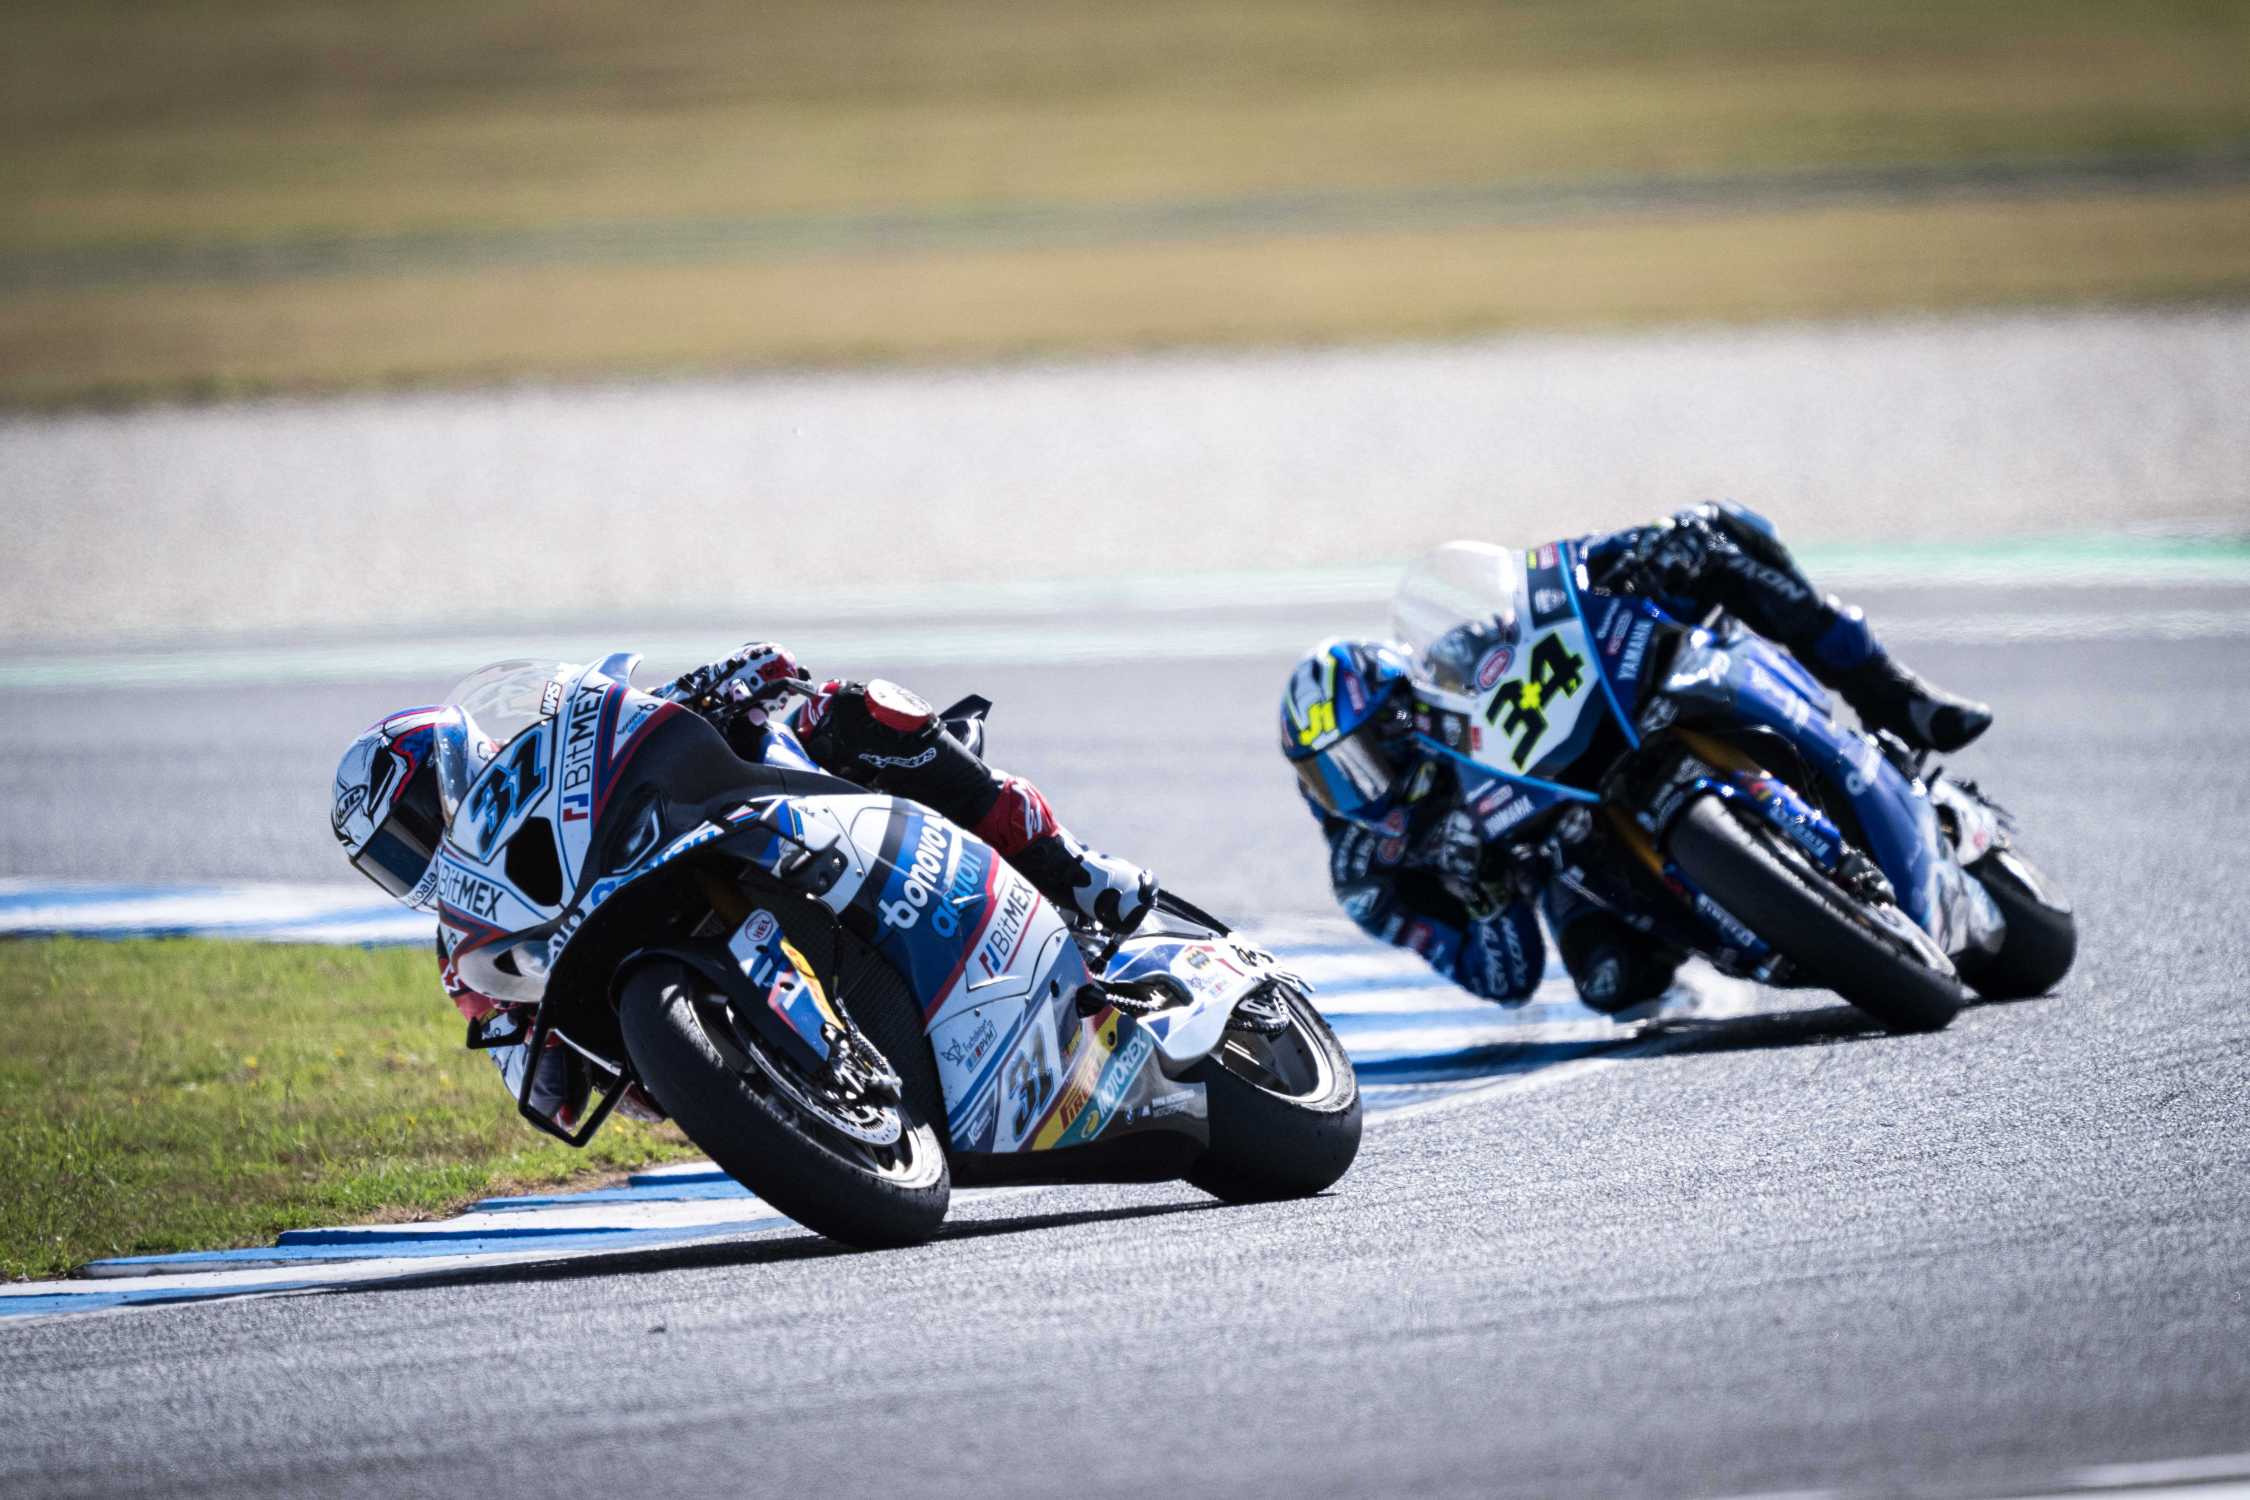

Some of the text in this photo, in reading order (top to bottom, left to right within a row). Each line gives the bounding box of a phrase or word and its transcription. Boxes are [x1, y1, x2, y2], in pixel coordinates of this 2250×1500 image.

[563, 683, 609, 791] BitMEX
[1485, 628, 1584, 772] 34
[469, 727, 547, 862] 31
[438, 865, 504, 922] BitMEX
[878, 824, 947, 929] bonovo
[990, 876, 1033, 957] BitMEX
[1008, 1022, 1054, 1142] 31
[1097, 1029, 1147, 1118] MOTOREX
